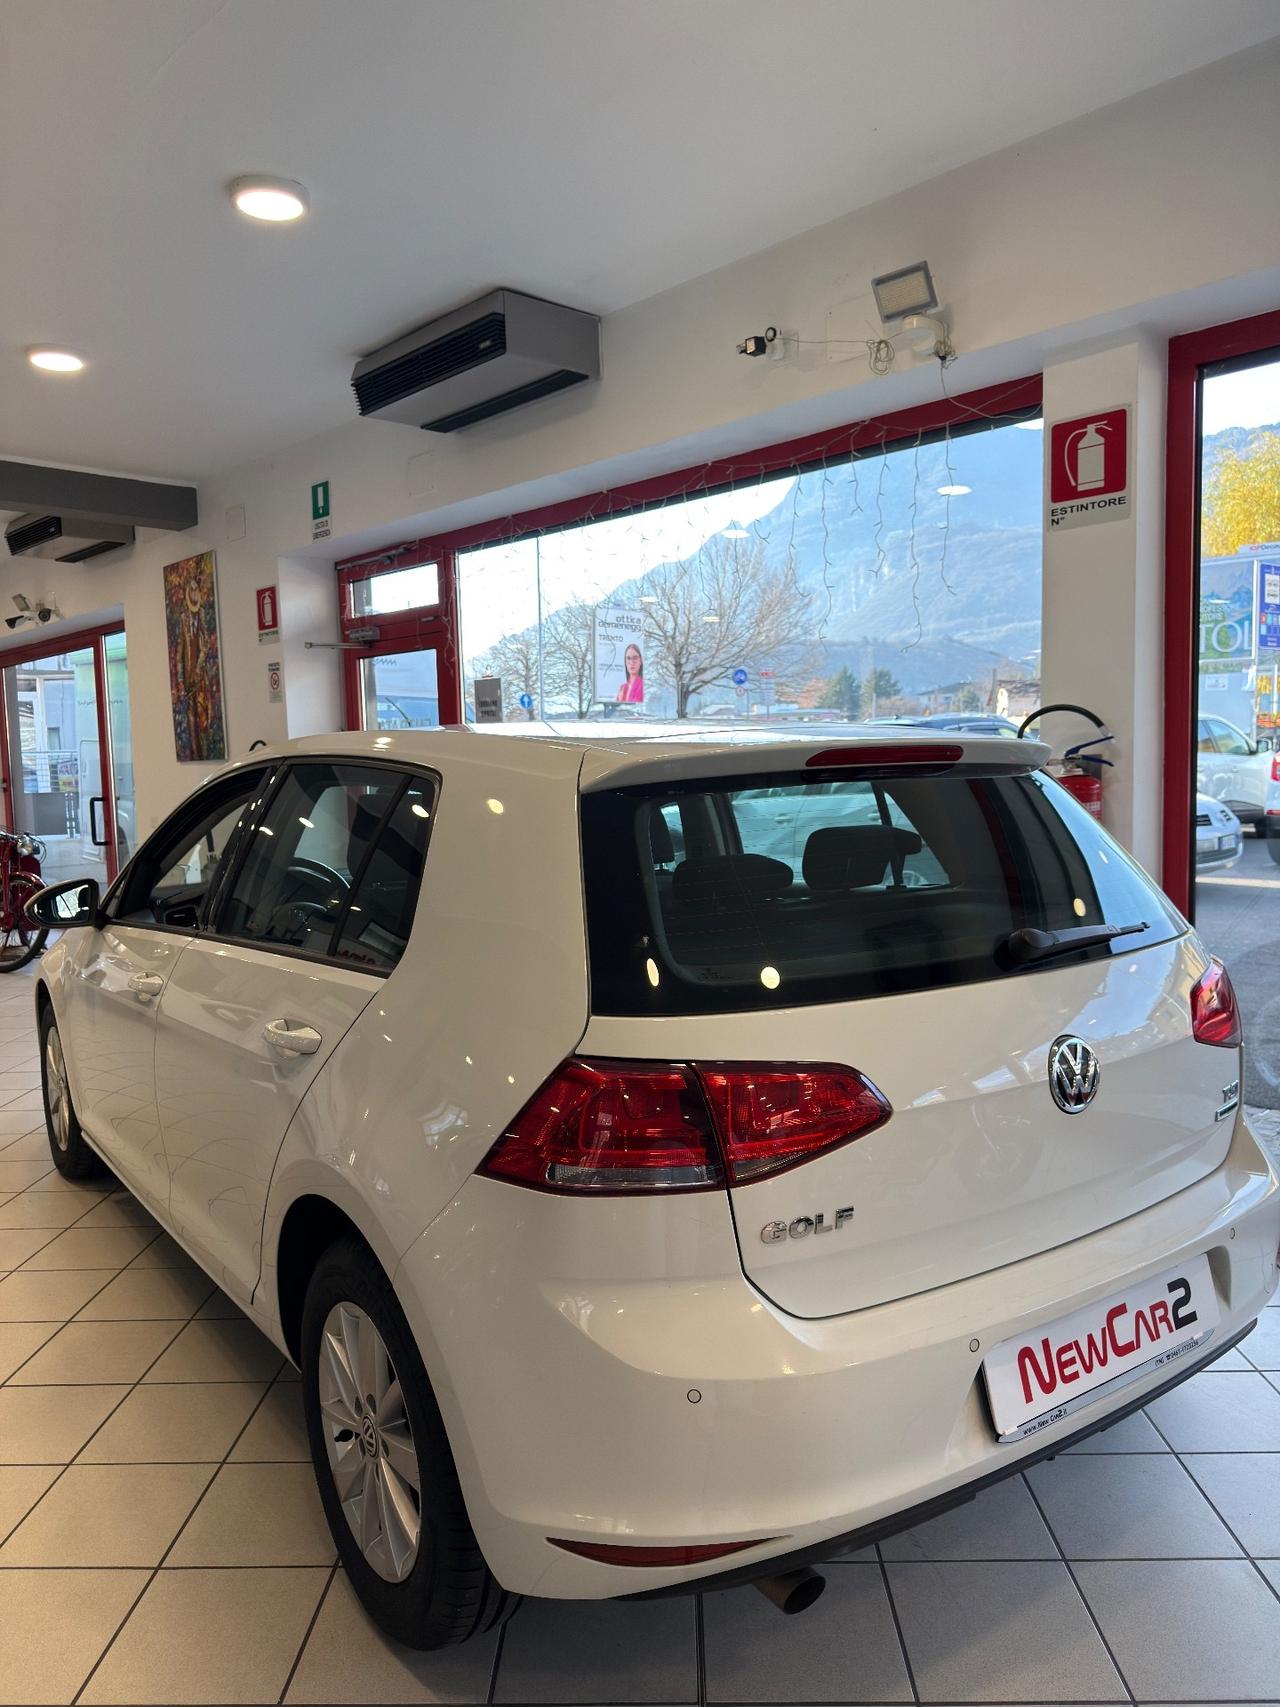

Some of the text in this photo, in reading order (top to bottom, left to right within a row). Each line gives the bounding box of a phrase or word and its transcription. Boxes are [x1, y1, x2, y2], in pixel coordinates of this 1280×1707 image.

[1051, 496, 1127, 517] ESTINTORE
[616, 614, 641, 624] ottica
[760, 1205, 855, 1245] GOLF
